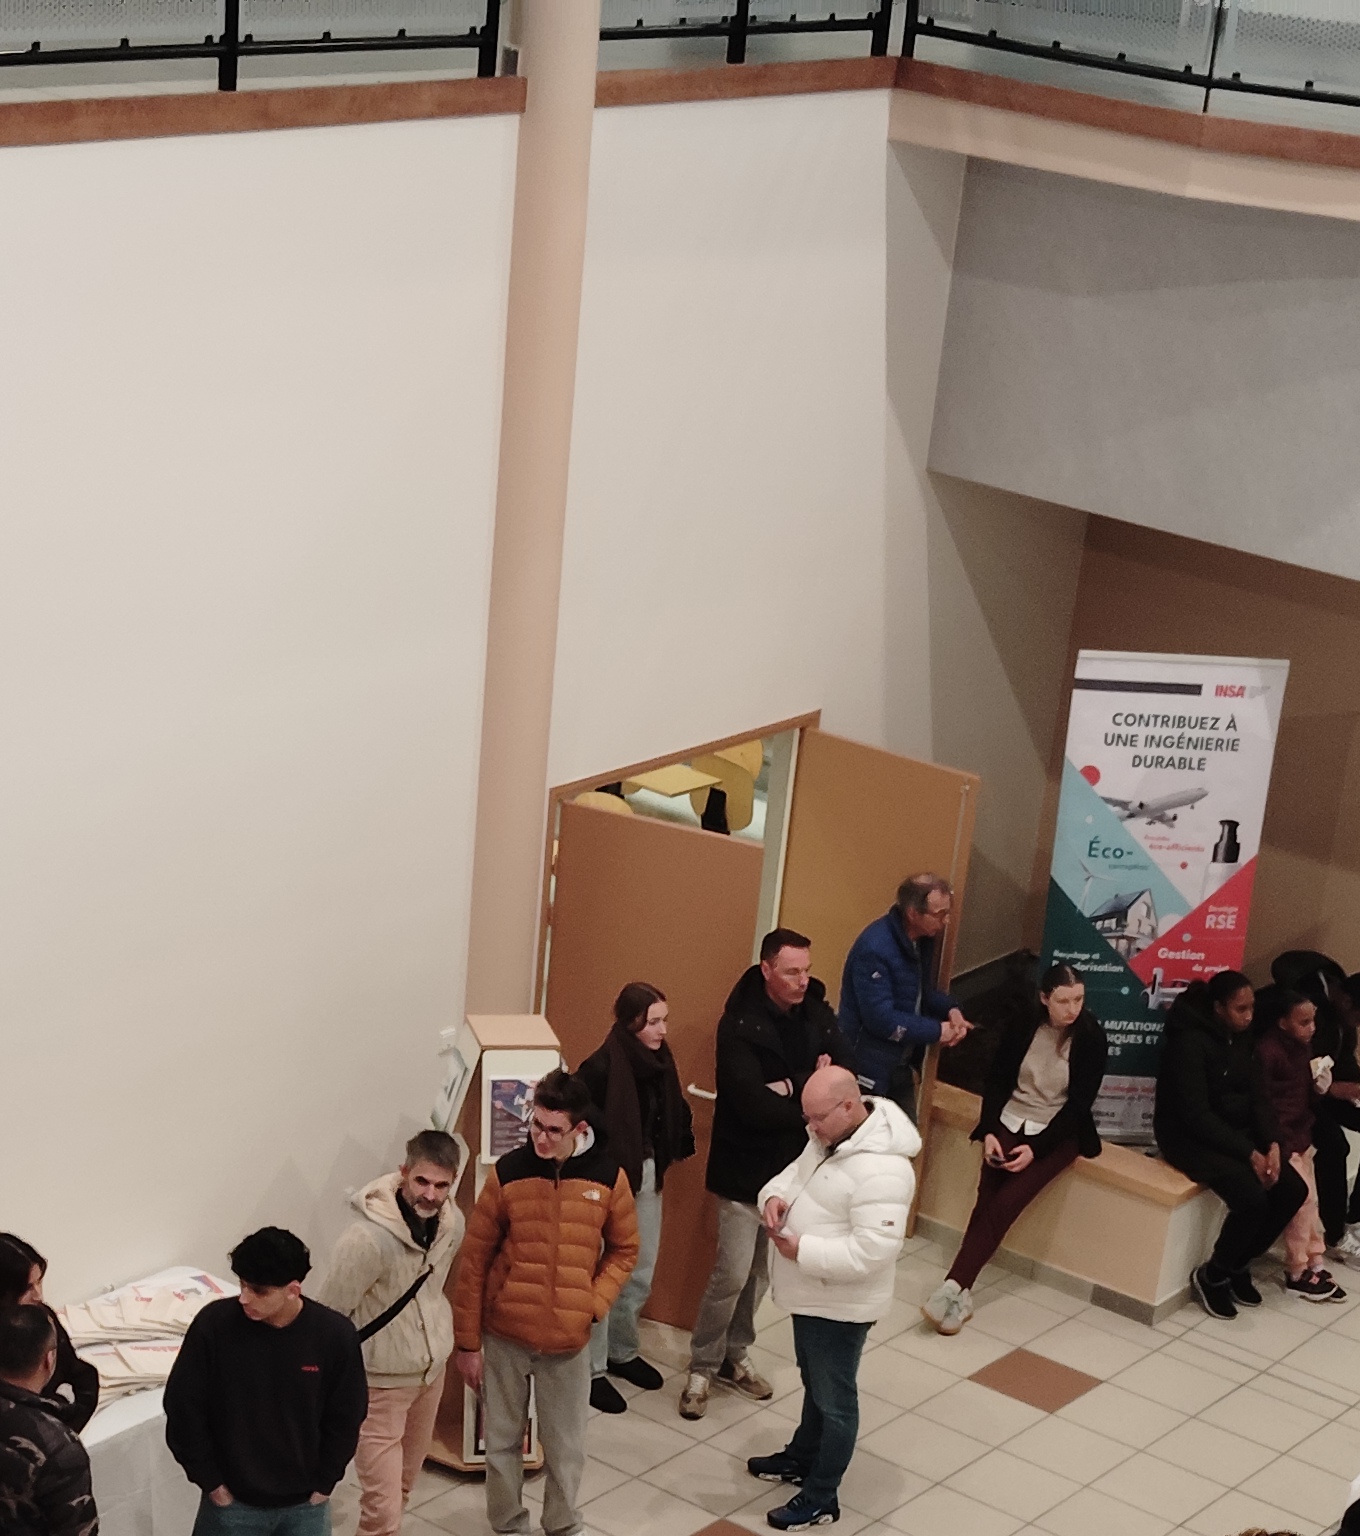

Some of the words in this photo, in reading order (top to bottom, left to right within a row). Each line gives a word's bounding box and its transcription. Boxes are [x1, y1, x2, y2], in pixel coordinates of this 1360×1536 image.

[1215, 684, 1246, 699] INSA
[1112, 712, 1220, 732] CONTRIBUEZ
[1225, 712, 1238, 732] À
[1103, 732, 1139, 748] UNE
[1143, 732, 1240, 752] INGÉNIERIE
[1131, 754, 1207, 771] DURABLE
[1088, 835, 1134, 860] Éco-
[1205, 914, 1237, 930] RSE
[1157, 947, 1206, 961] Gestion
